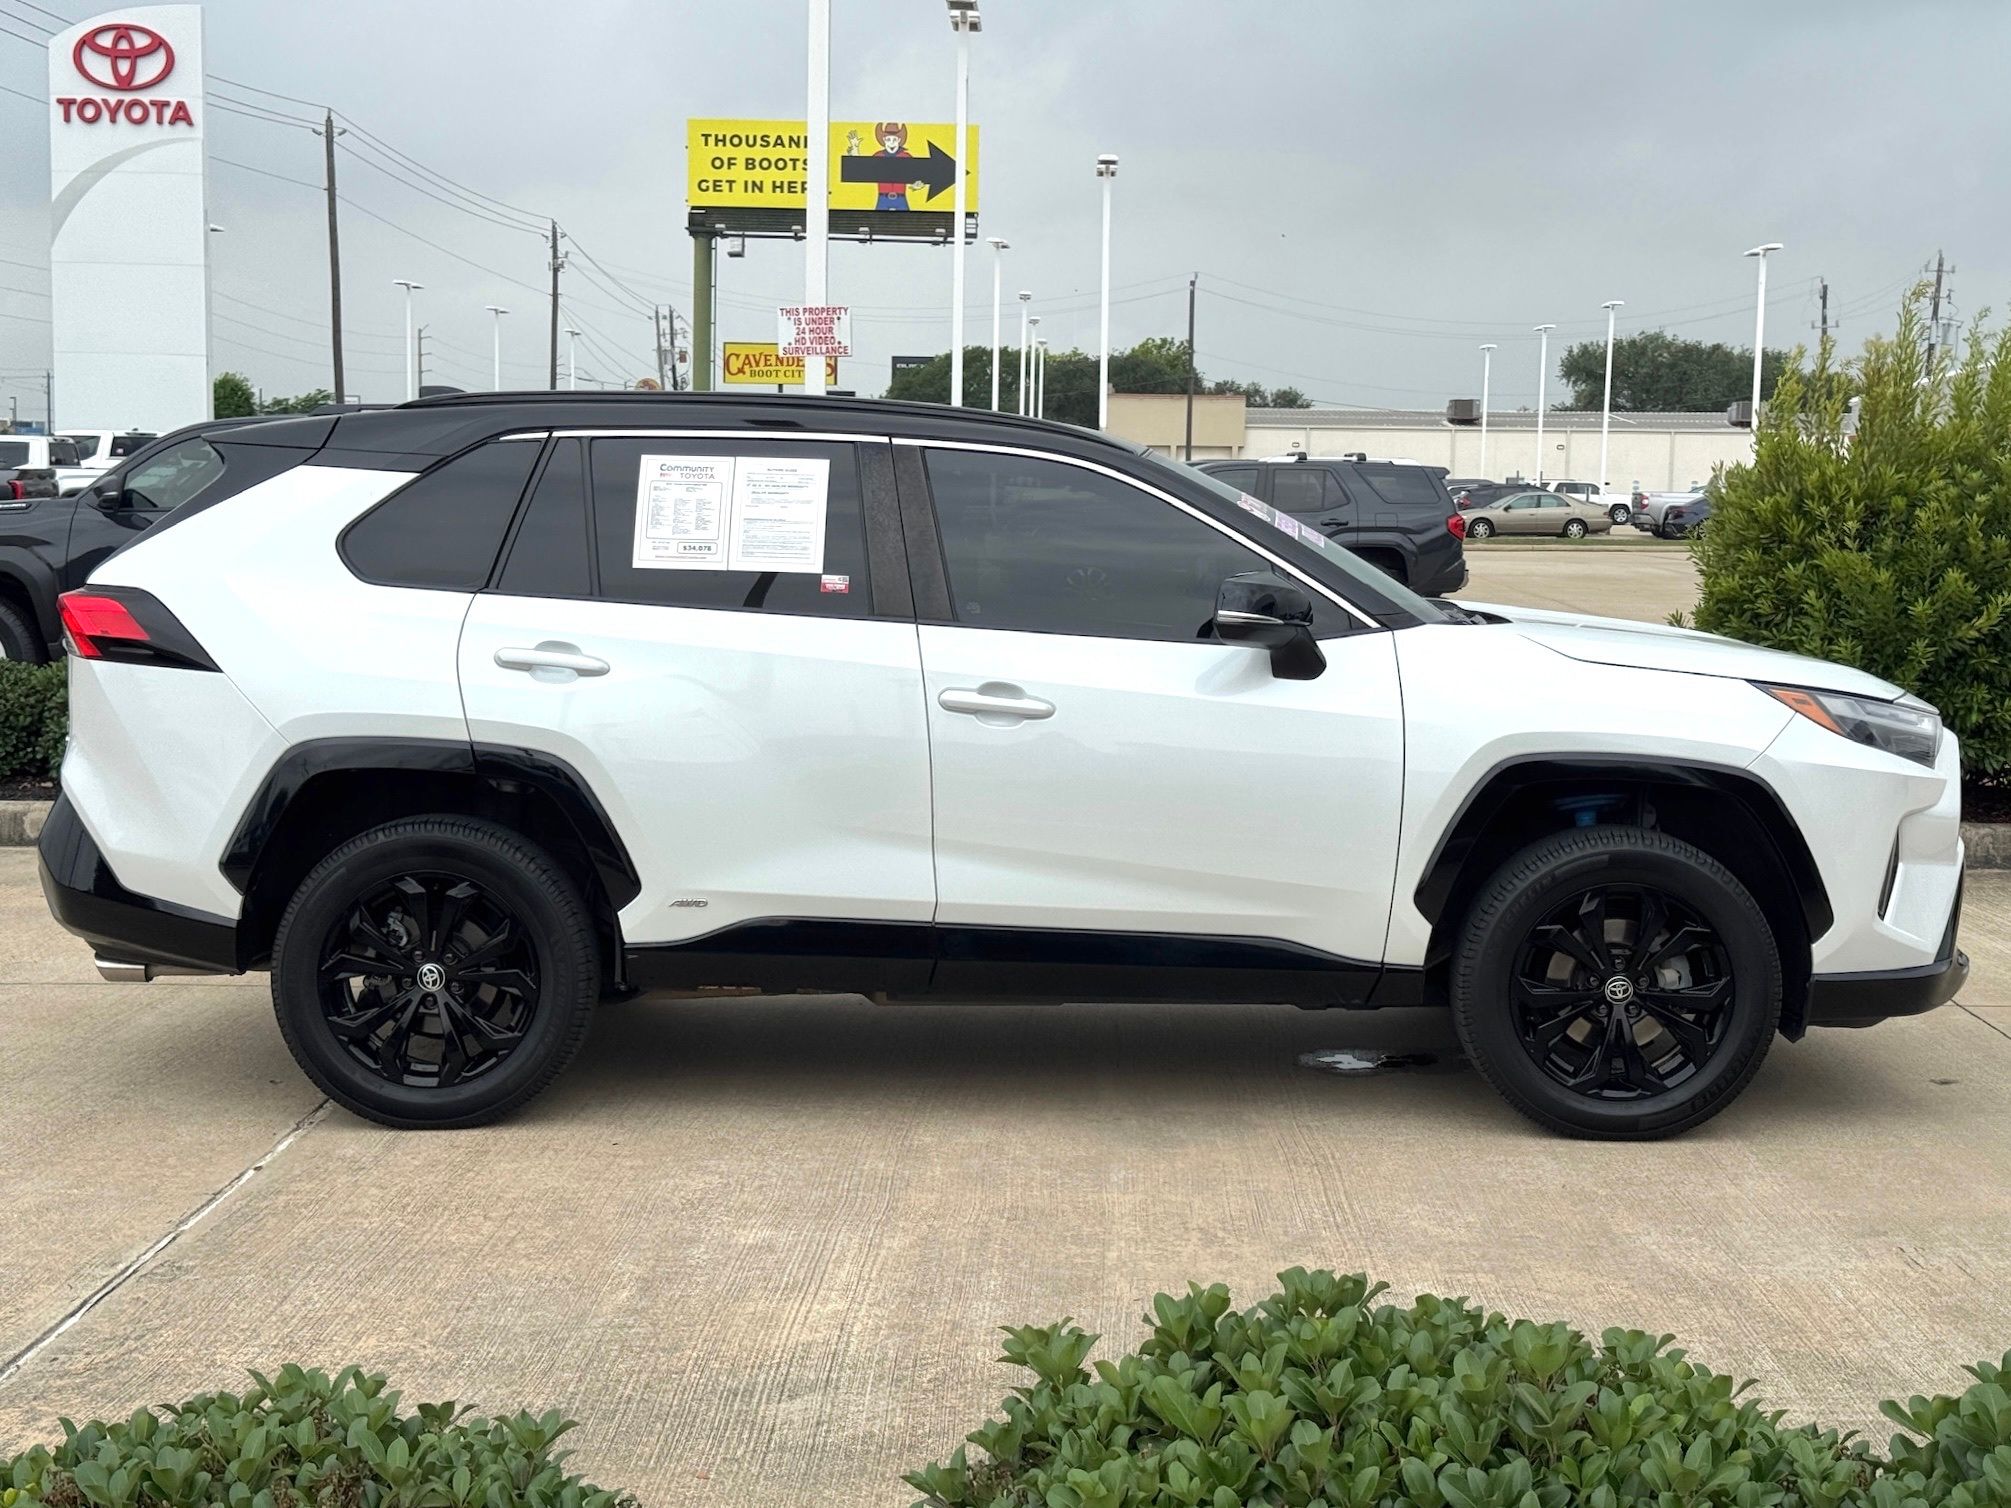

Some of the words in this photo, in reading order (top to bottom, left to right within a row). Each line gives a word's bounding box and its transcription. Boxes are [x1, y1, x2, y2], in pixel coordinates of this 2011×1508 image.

[56, 97, 194, 127] TOYOTA
[701, 133, 808, 149] THOUSAN
[711, 156, 737, 170] OF
[697, 179, 736, 193] GET
[744, 180, 764, 194] IN
[780, 307, 800, 317] THIS
[802, 306, 849, 316] PROPERTY
[793, 317, 802, 326] IS
[805, 316, 835, 326] UNDER
[795, 327, 806, 336] 24
[808, 326, 834, 336] HOUR
[794, 337, 807, 346] HD
[808, 336, 836, 346] VIDEO
[782, 346, 849, 356] SURVEILLANCE
[749, 369, 781, 378] BOOT
[783, 369, 804, 378] CIT
[680, 472, 716, 480] TOYOTA
